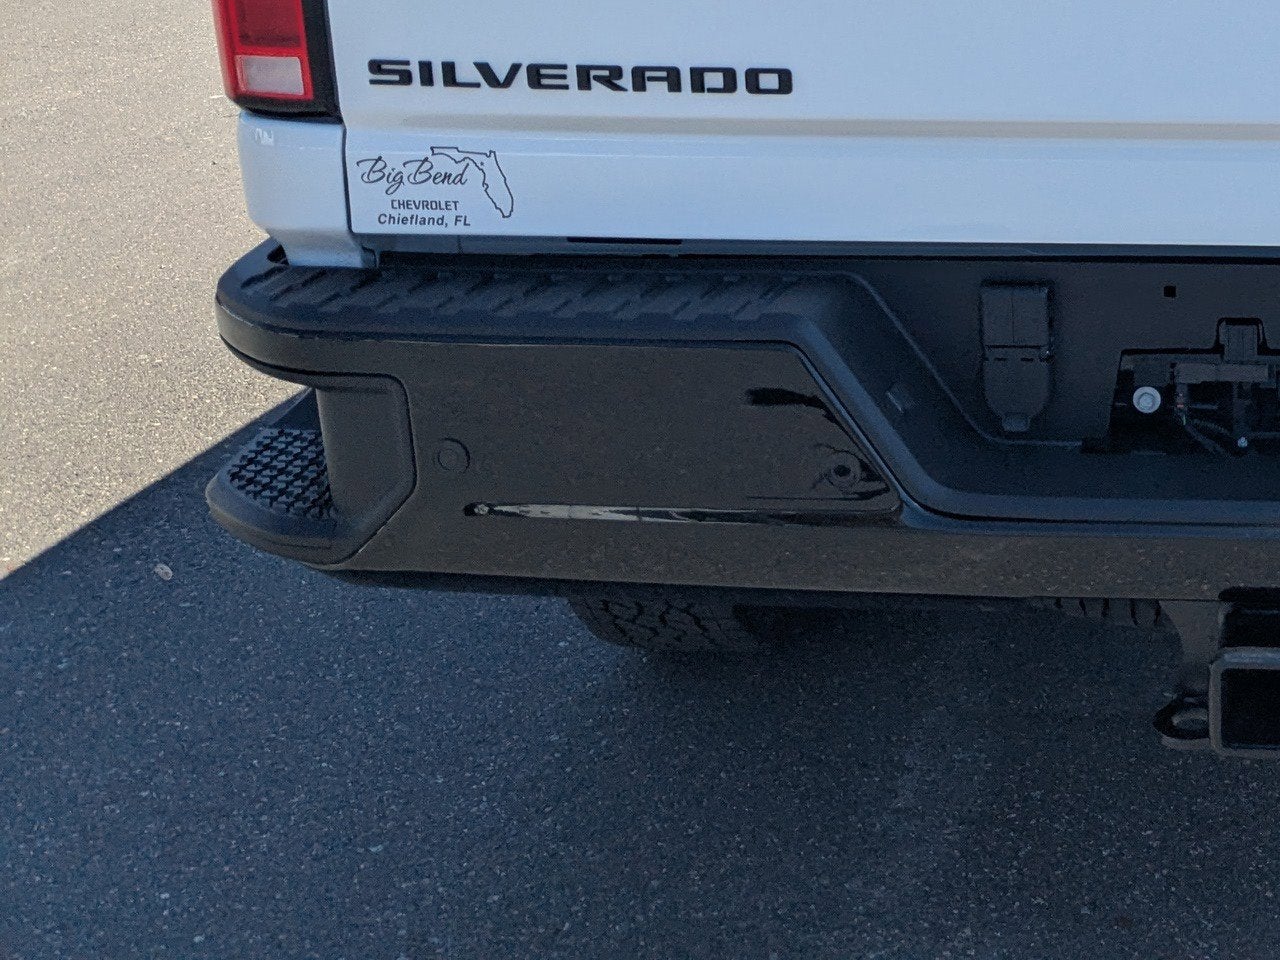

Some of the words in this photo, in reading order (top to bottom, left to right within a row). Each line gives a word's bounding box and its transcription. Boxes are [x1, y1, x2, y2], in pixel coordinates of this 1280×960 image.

[368, 58, 794, 95] SILVERADO
[356, 155, 404, 195] Big
[403, 156, 470, 185] Bend
[391, 199, 460, 211] CHEVROLET
[378, 213, 449, 228] Chiefland,
[454, 214, 471, 227] FL
